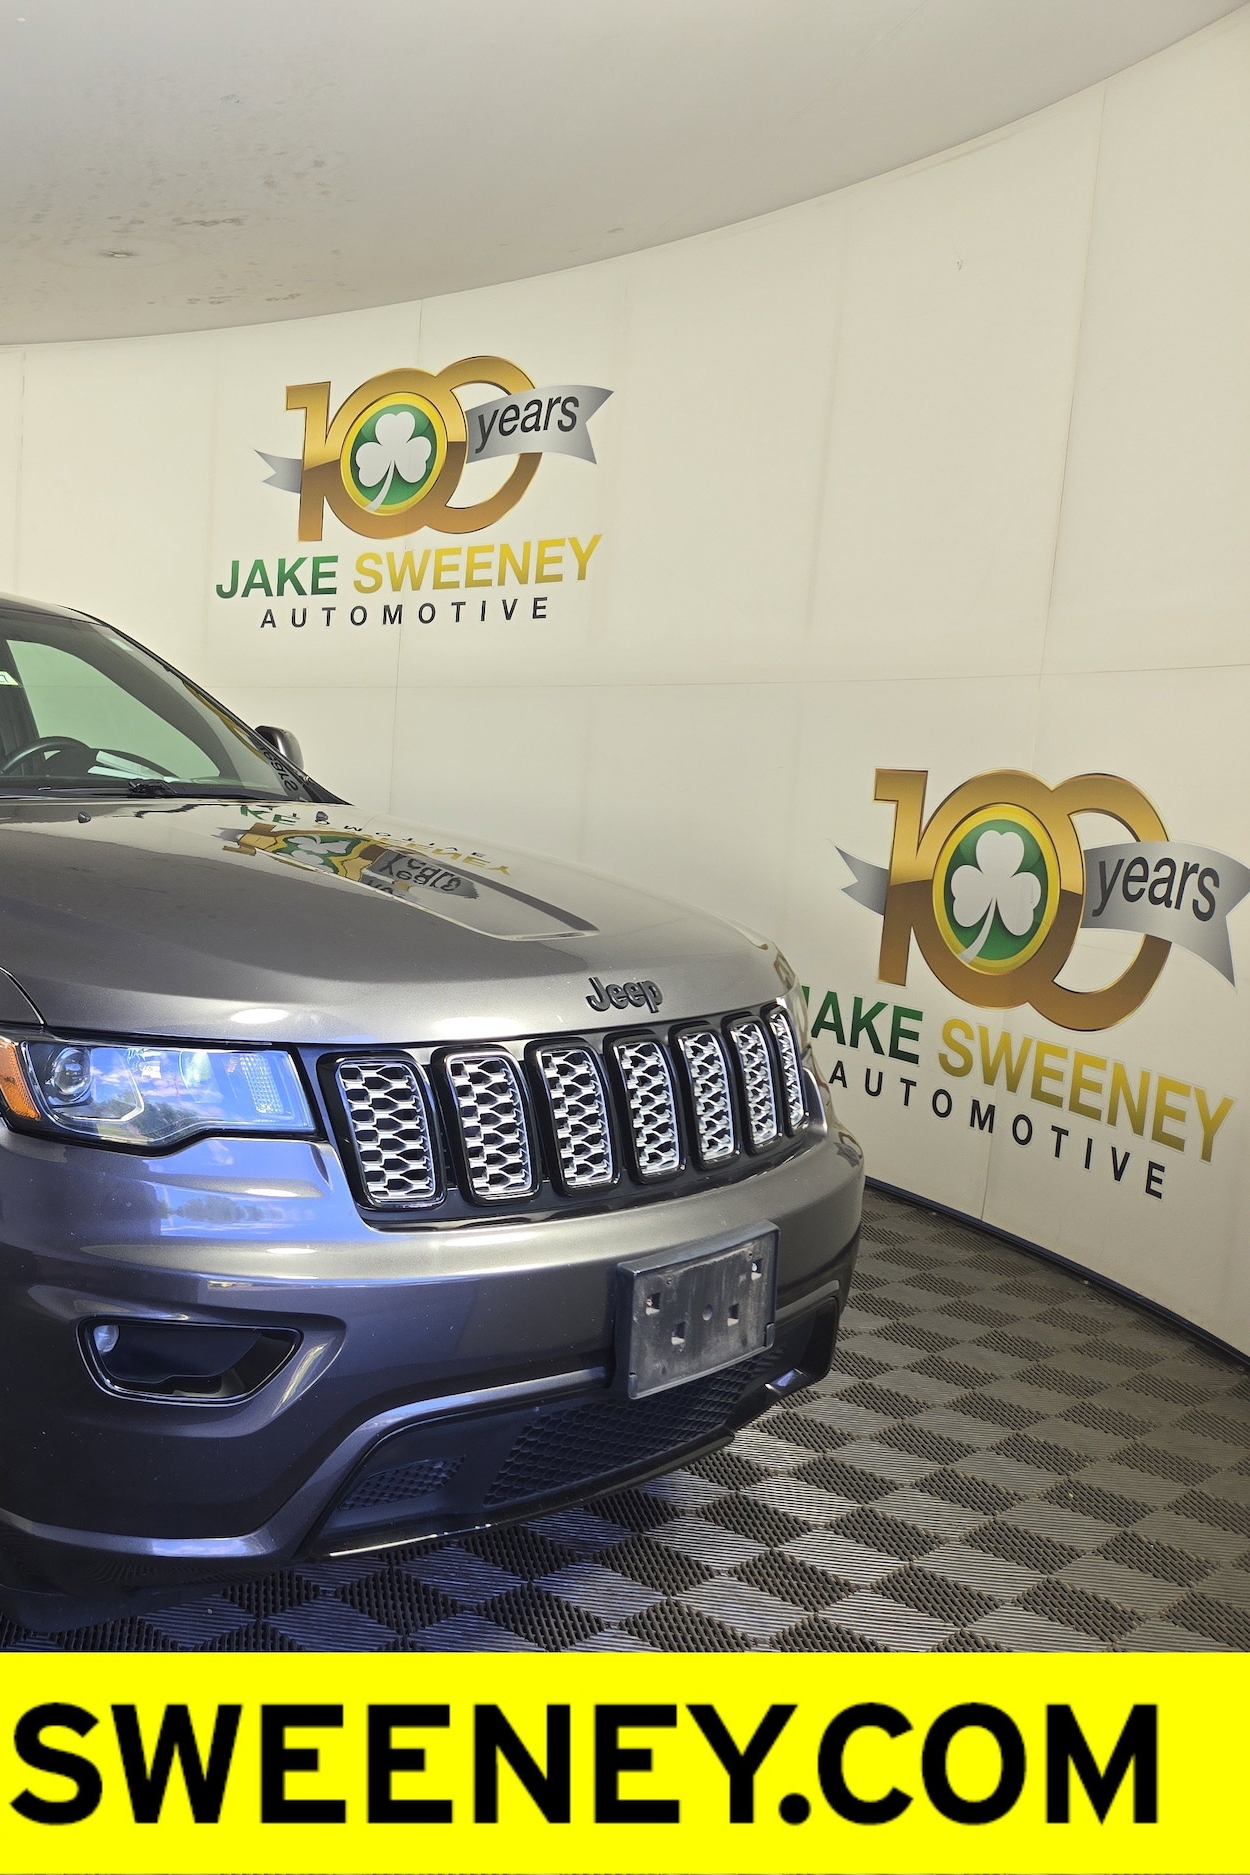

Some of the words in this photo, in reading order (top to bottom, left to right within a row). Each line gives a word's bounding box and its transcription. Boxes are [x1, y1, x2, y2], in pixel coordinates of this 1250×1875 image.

[286, 355, 542, 541] 100
[475, 394, 580, 453] years
[216, 555, 338, 598] JAKE
[353, 534, 602, 592] SWEENEY
[260, 596, 548, 629] AUTOMOTIVE
[874, 768, 1172, 1031] 100
[1092, 856, 1220, 922] years
[585, 976, 664, 1014] Jeep
[938, 1018, 1234, 1163] SWEENEY
[829, 1060, 1166, 1199] AUTOMOTIVE
